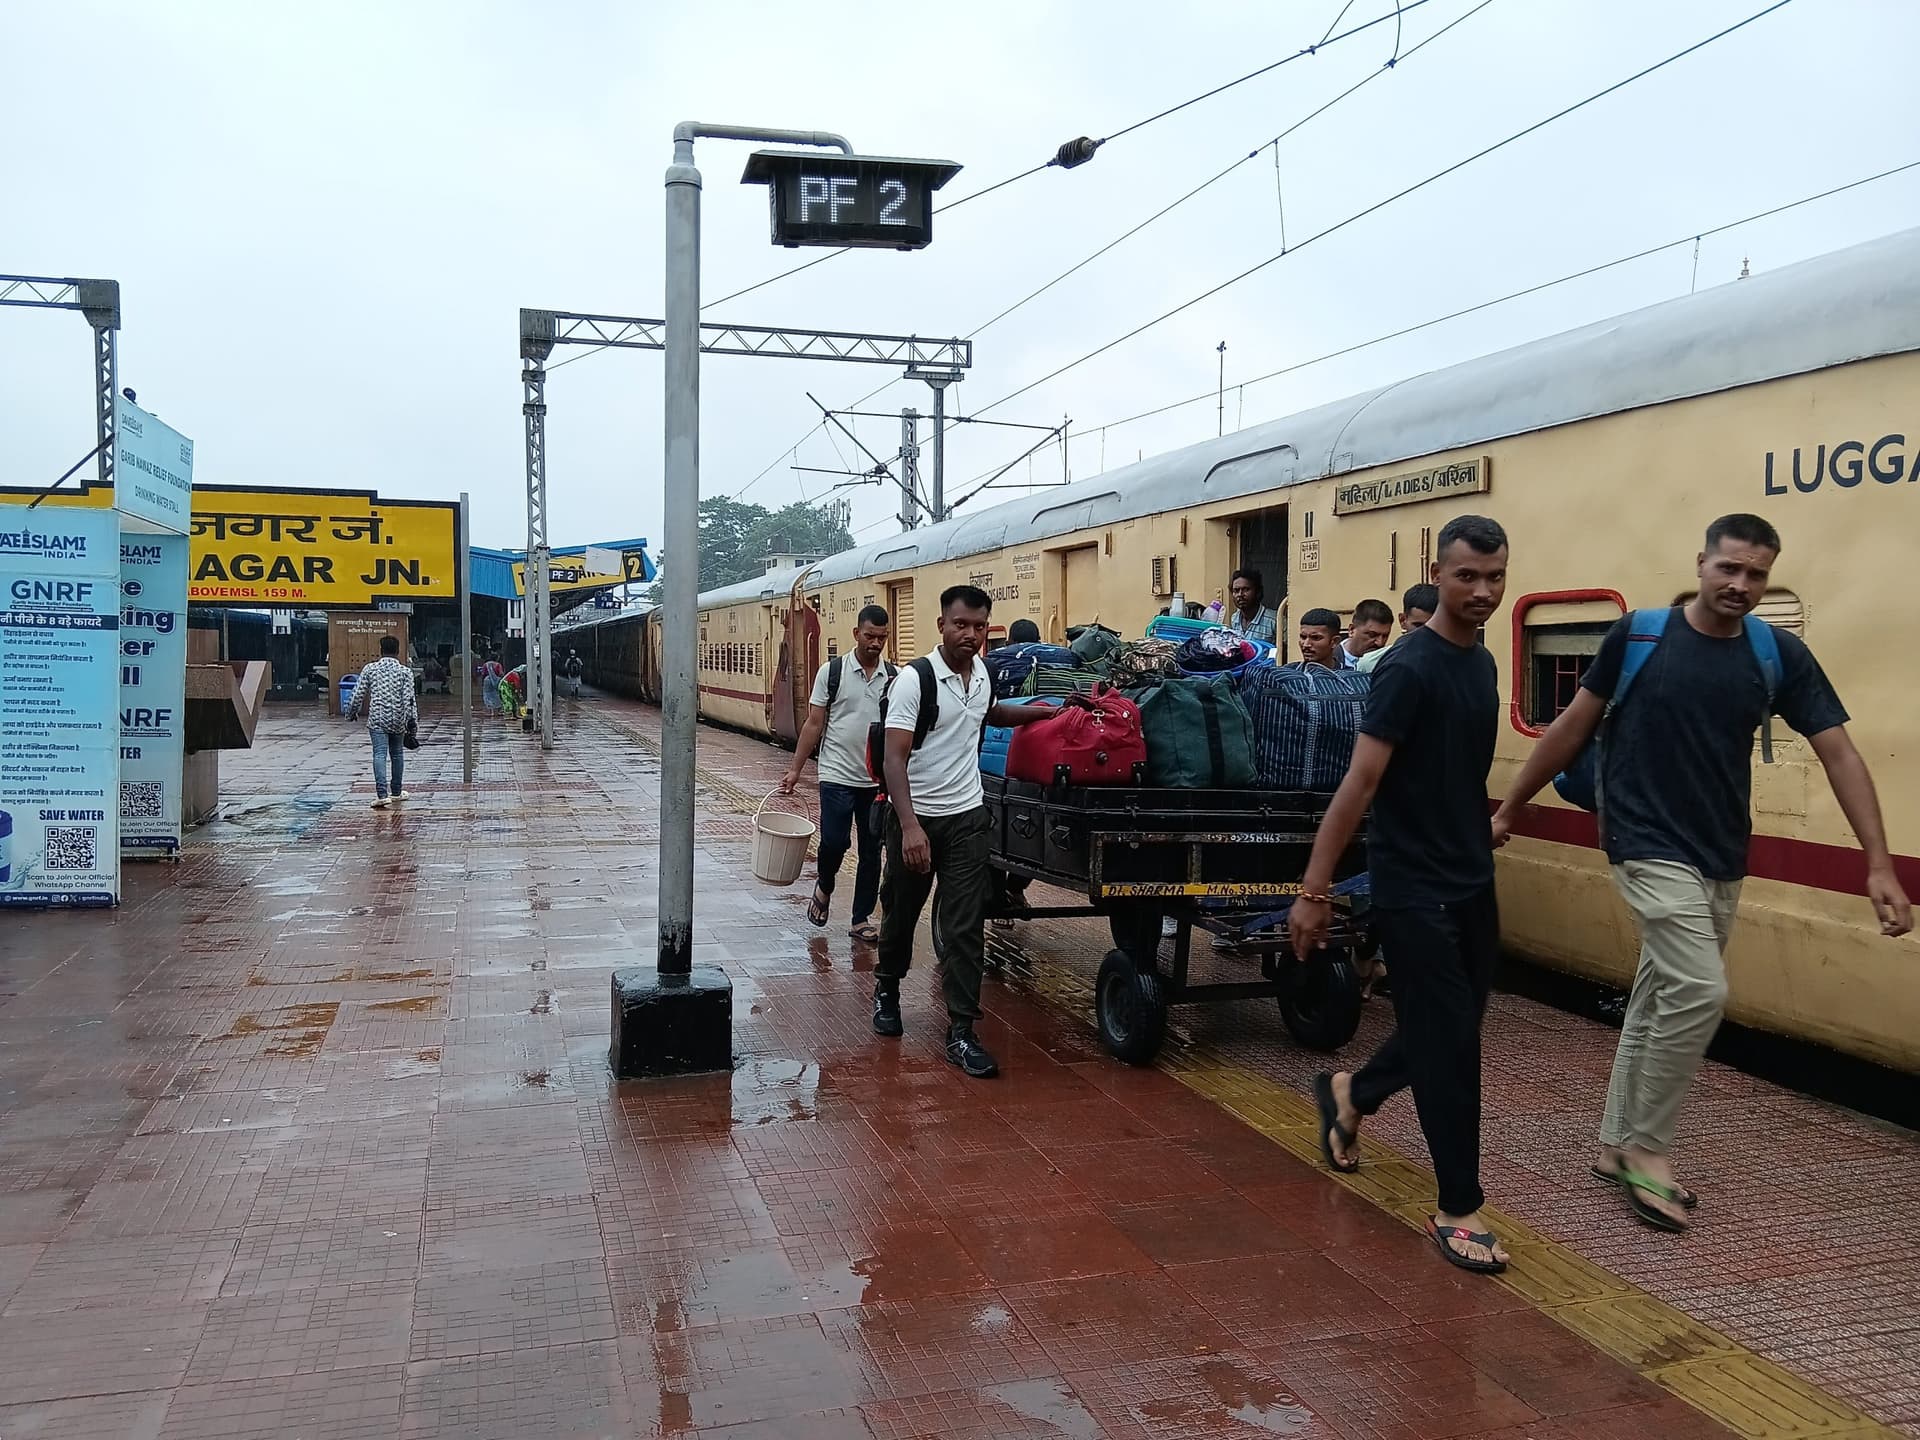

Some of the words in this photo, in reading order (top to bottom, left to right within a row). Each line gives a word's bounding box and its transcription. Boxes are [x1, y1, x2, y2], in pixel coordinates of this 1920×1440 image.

[800, 176, 858, 223] PF
[879, 180, 906, 225] 2
[121, 449, 135, 467] GARIB
[136, 456, 152, 475] NAWAZ
[153, 464, 168, 481] RELIEF
[168, 472, 191, 494] FOUNDATION
[135, 485, 156, 504] DRINKING
[156, 493, 168, 509] WATER
[44, 550, 76, 559] INDIA
[188, 554, 335, 584] AGAR
[360, 559, 430, 586] JN.
[552, 570, 564, 579] PF
[568, 572, 573, 580] 2
[628, 558, 642, 578] 2
[11, 580, 93, 602] GNRF
[120, 580, 142, 596] e
[264, 588, 288, 598] 159
[292, 588, 307, 598] M.
[15, 613, 34, 624] पीने
[36, 614, 47, 624] के
[49, 617, 56, 625] 8
[120, 641, 155, 656] er
[40, 810, 65, 820] SAVE
[68, 810, 104, 820] WATER
